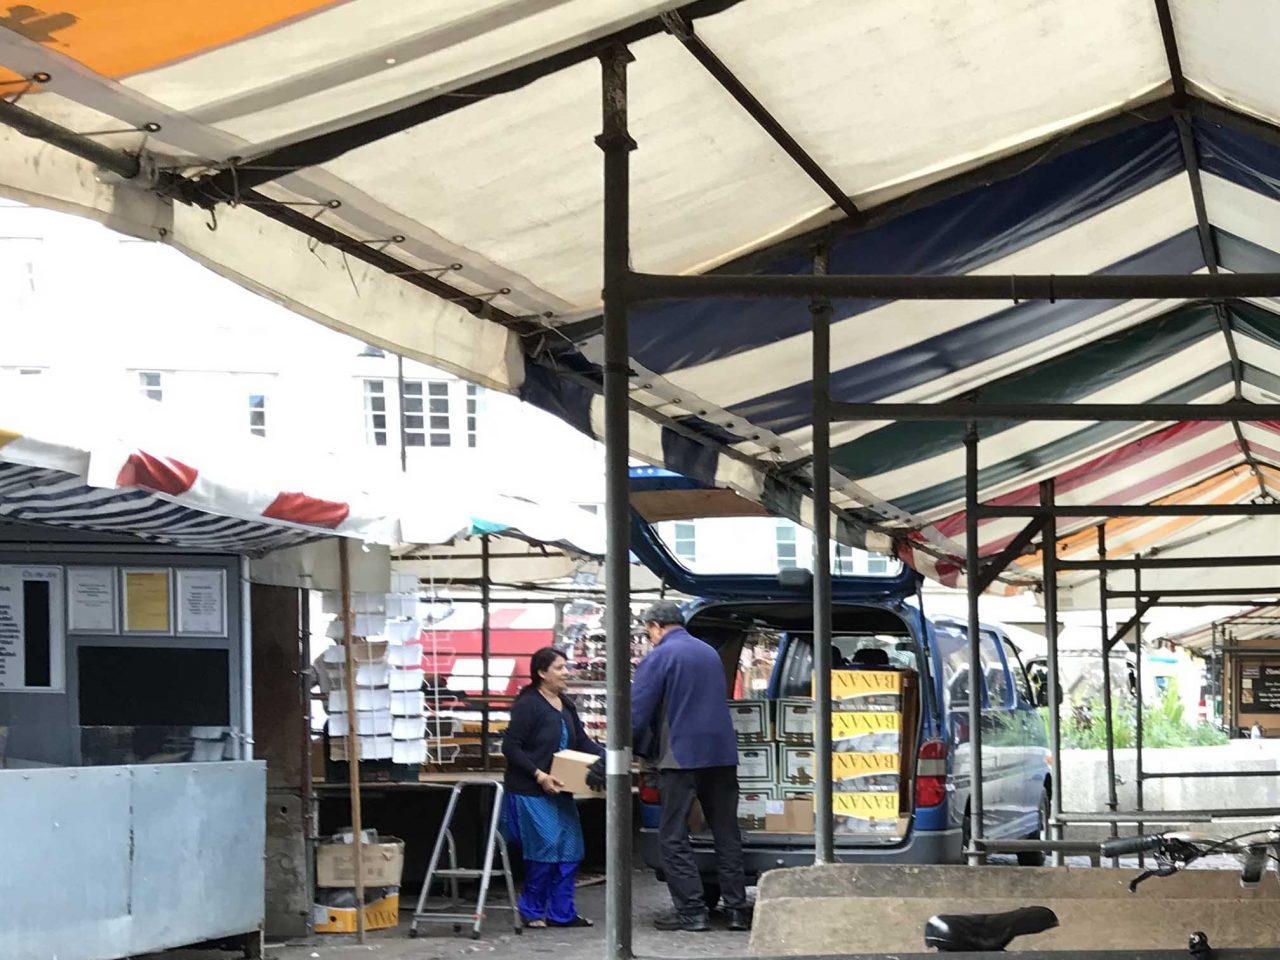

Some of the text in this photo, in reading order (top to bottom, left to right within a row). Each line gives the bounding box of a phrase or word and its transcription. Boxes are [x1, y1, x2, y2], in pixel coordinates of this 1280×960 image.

[835, 674, 895, 688] BANAN
[835, 714, 895, 729] BANAN
[835, 754, 894, 768] BANAN
[835, 795, 895, 809] BANAN
